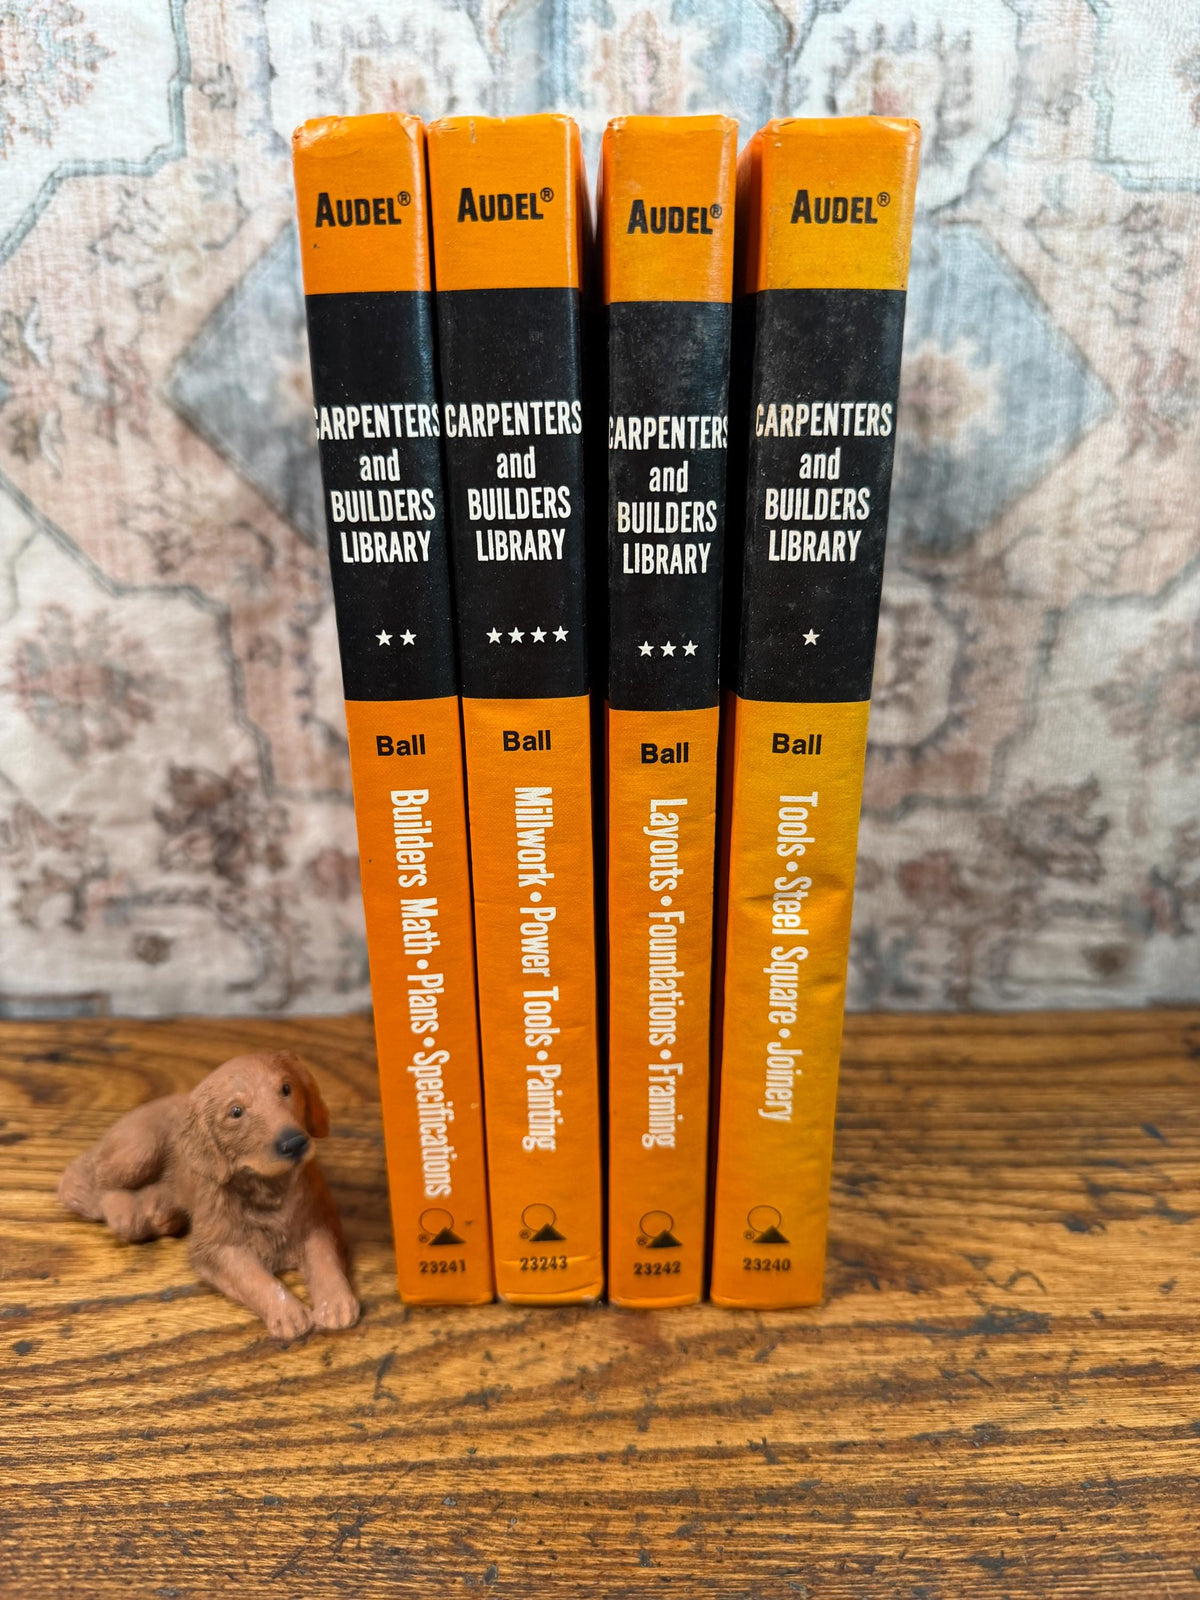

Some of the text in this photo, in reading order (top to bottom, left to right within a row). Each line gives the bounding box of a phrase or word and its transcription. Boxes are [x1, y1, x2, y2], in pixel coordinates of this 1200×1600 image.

[445, 401, 582, 438] CARPENTERS
[755, 403, 893, 438] CARPENTERS
[360, 449, 400, 482] and
[497, 447, 536, 480] and
[650, 461, 688, 493] and
[799, 448, 840, 480] and
[331, 489, 435, 523] BUILDERS
[468, 486, 571, 521] BUILDERS
[617, 501, 717, 534] BUILDERS
[765, 487, 870, 521] BUILDERS
[341, 530, 431, 564] LIBRARY
[476, 529, 566, 562] LIBRARY
[623, 543, 711, 575] LIBRARY
[768, 530, 862, 563] LIBRARY
[376, 734, 425, 758] Ball
[503, 730, 551, 752] Ball
[640, 743, 689, 766] Ball
[771, 733, 822, 756] Ball
[515, 787, 564, 1152] Millwork Power Tools Painting
[758, 791, 818, 1122] Tools Steel Square Joinery
[642, 798, 687, 1149] Layouts Foundations Framing
[390, 789, 457, 1198] Builders Math Plans Specifications
[420, 1259, 466, 1274] 23241
[520, 1256, 567, 1272] 23243
[634, 1261, 681, 1276] 23242
[742, 1258, 791, 1272] 23240
